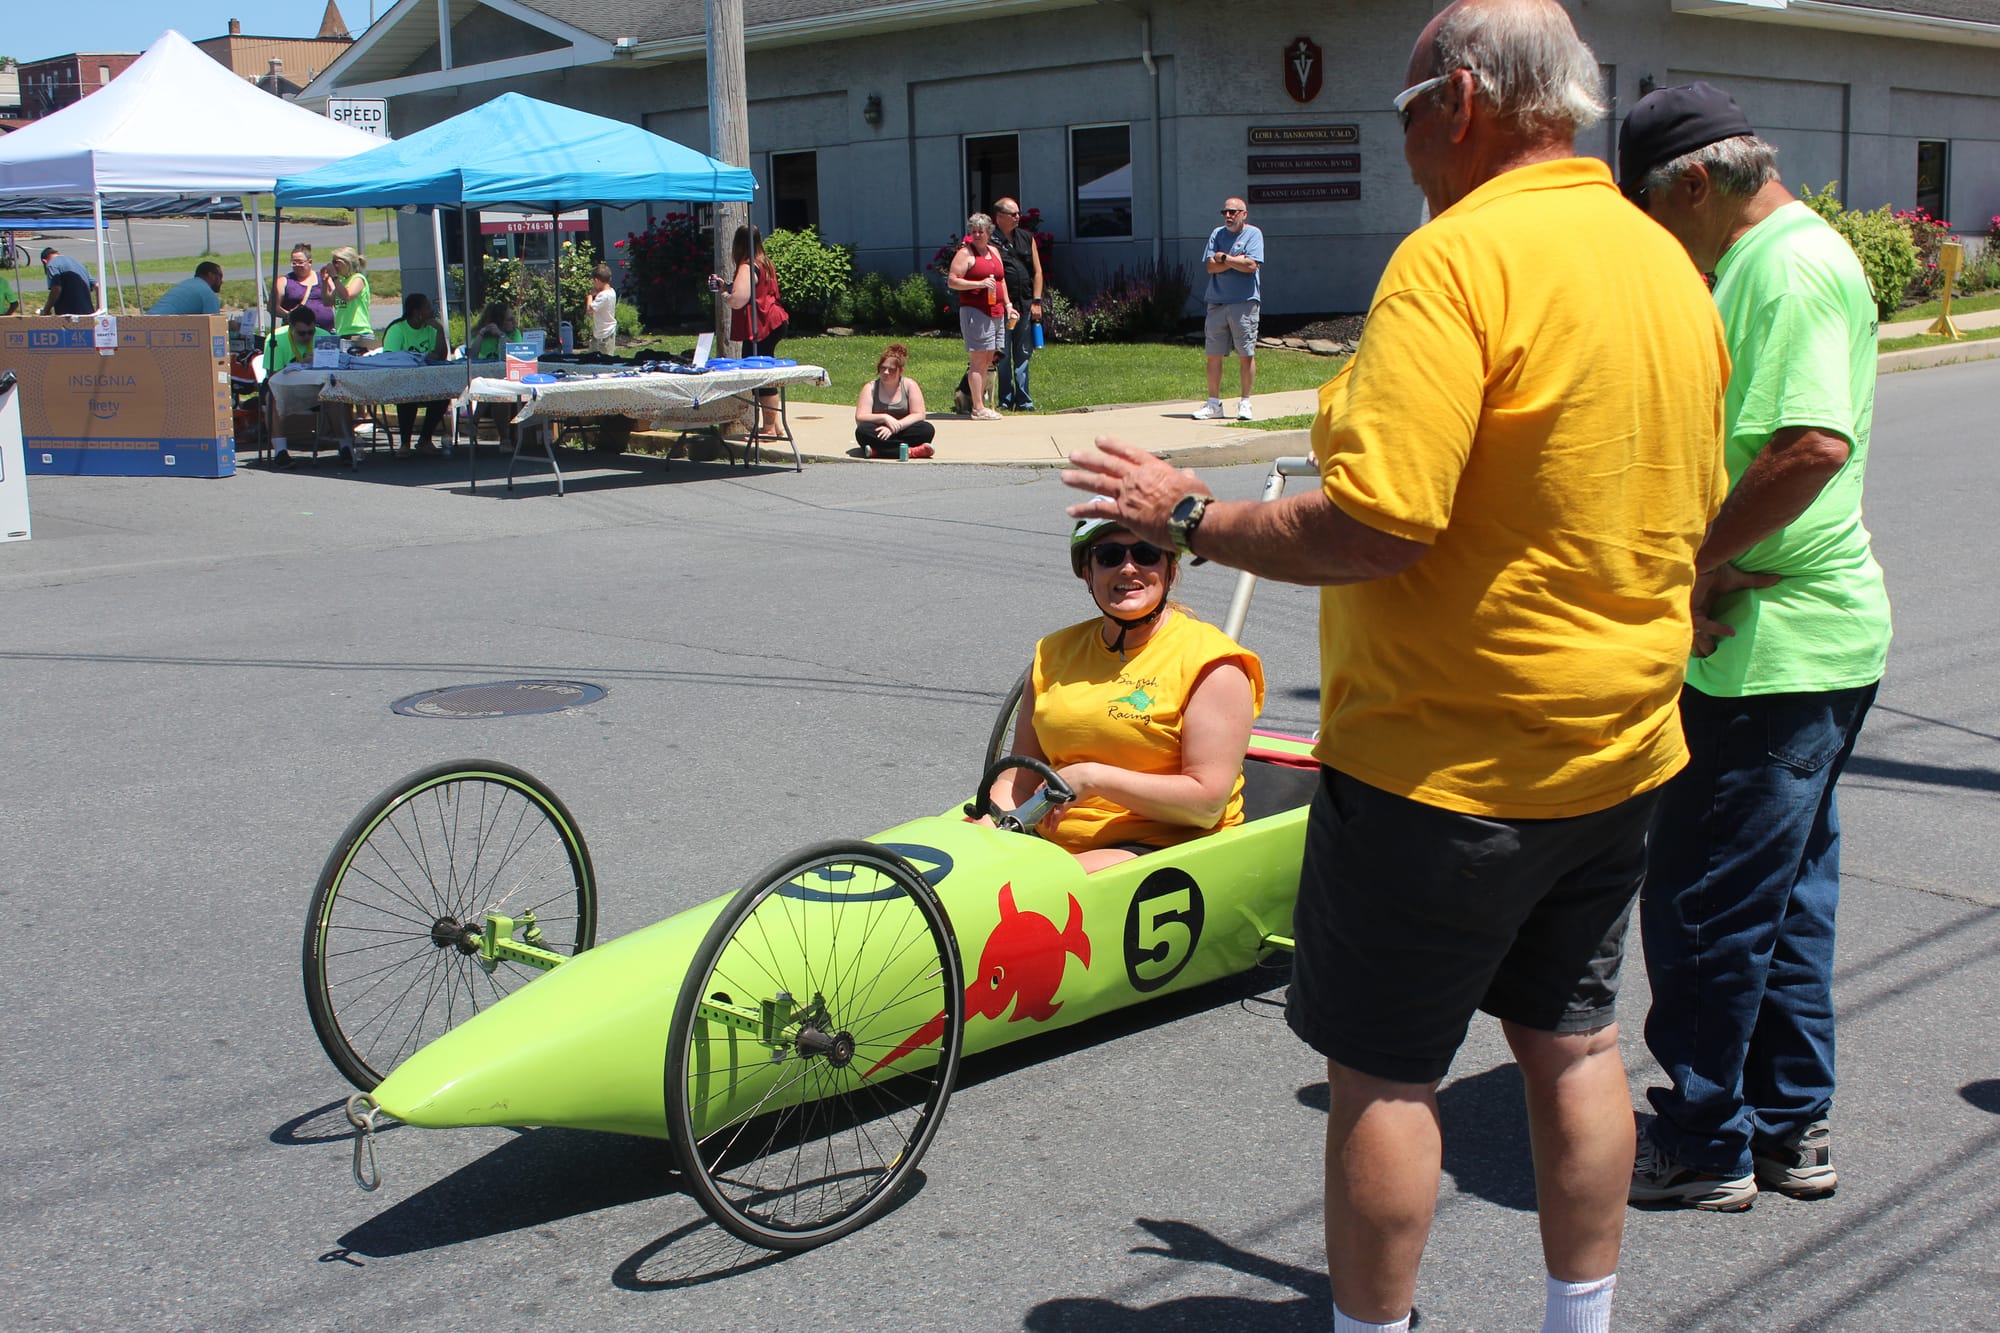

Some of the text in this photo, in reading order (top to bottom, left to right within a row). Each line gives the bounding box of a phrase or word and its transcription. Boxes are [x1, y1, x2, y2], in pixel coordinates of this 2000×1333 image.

[334, 109, 381, 121] SPEED
[1255, 131, 1272, 139] LORI
[1256, 161, 1293, 169] VICTORIA
[33, 333, 59, 346] LED
[71, 332, 86, 343] 4K
[68, 375, 136, 387] INSIGNIA
[1108, 705, 1151, 725] Racing
[1135, 888, 1192, 981] 5
